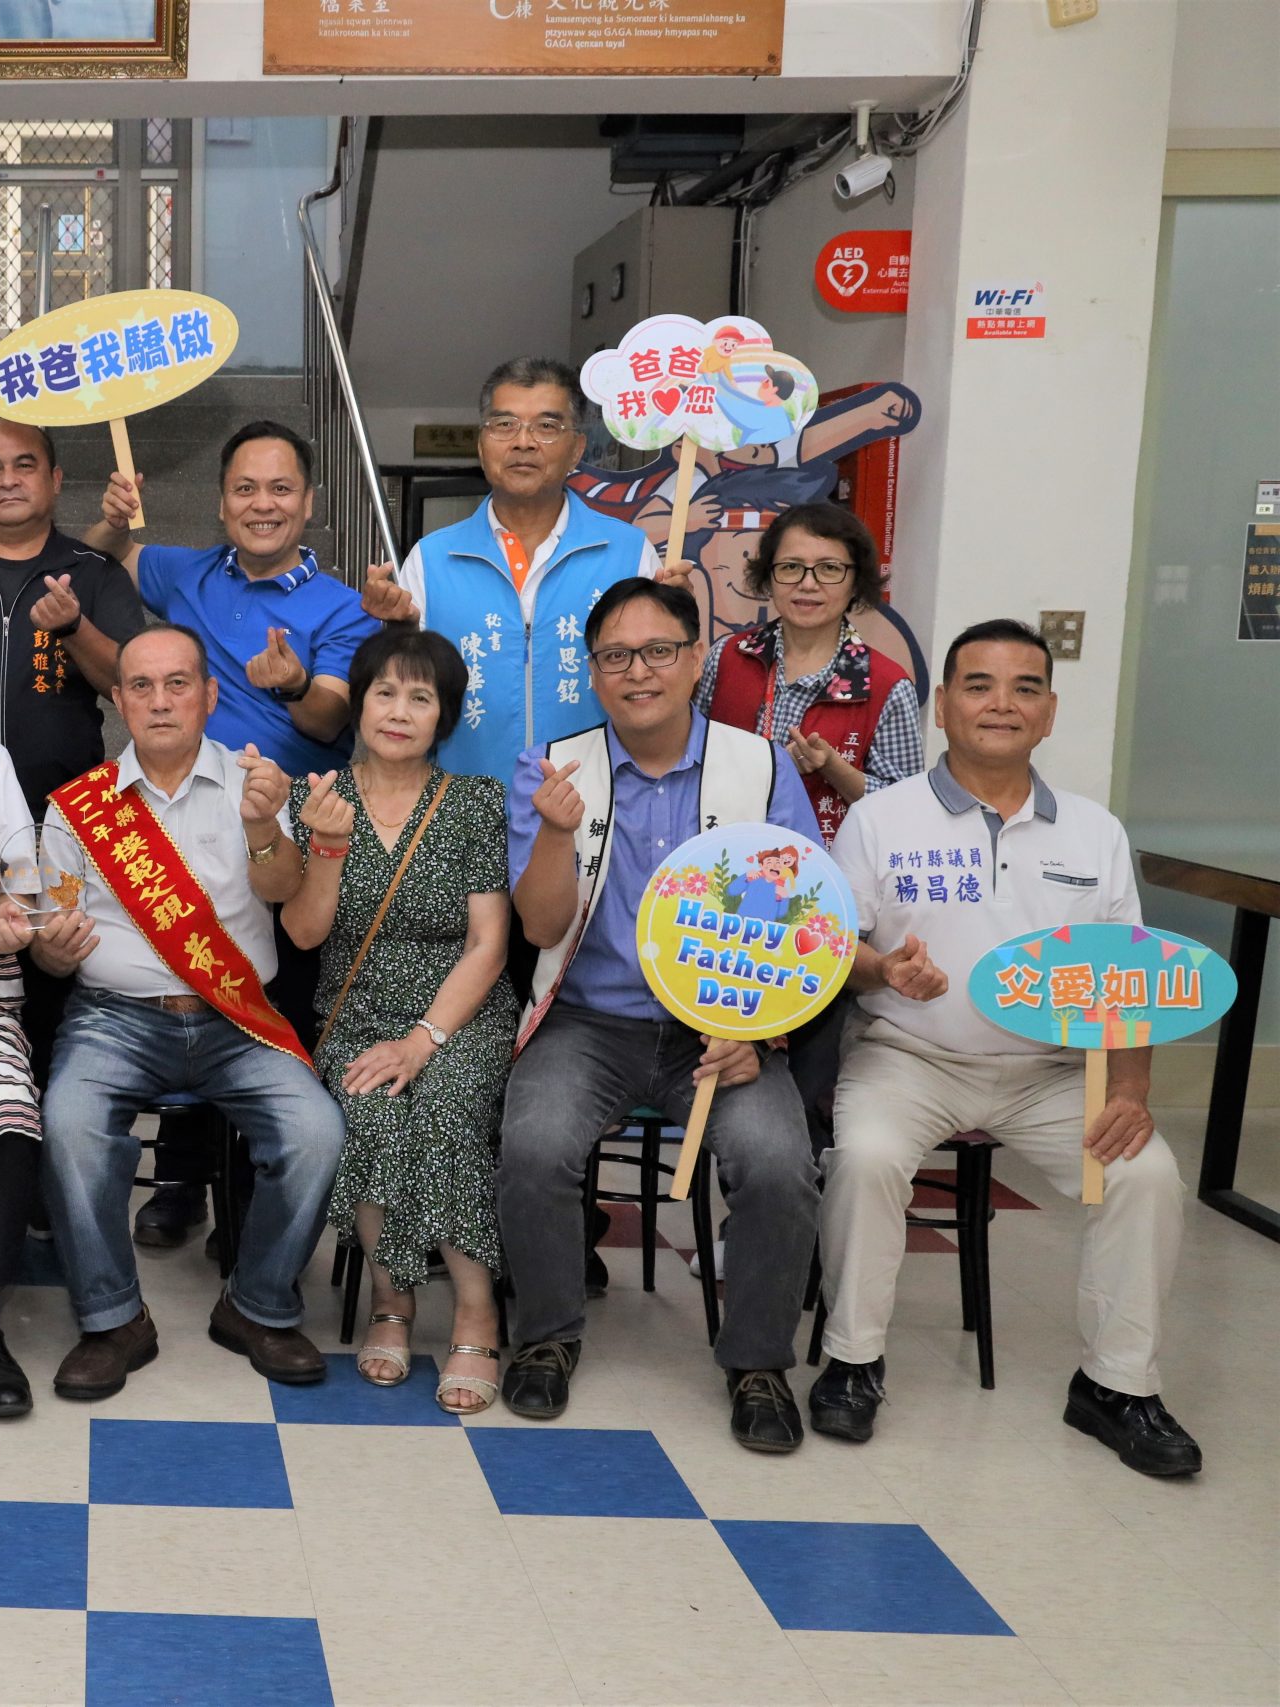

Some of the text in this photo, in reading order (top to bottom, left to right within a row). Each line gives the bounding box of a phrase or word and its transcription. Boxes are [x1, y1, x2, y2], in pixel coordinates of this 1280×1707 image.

[833, 247, 864, 258] AED
[975, 289, 1035, 305] Wi-Fi
[629, 345, 702, 383] 爸爸
[617, 385, 716, 420] 我 您
[886, 478, 896, 510] External
[485, 613, 502, 651] 秘書
[556, 614, 584, 704] 林思銘
[888, 848, 983, 869] 新竹縣議員
[110, 831, 196, 932] 模範父親
[894, 873, 983, 904] 楊昌德
[675, 898, 789, 951] Happy
[676, 936, 821, 996] Father's
[695, 977, 763, 1018] Day
[995, 962, 1203, 1010] 父愛如山
